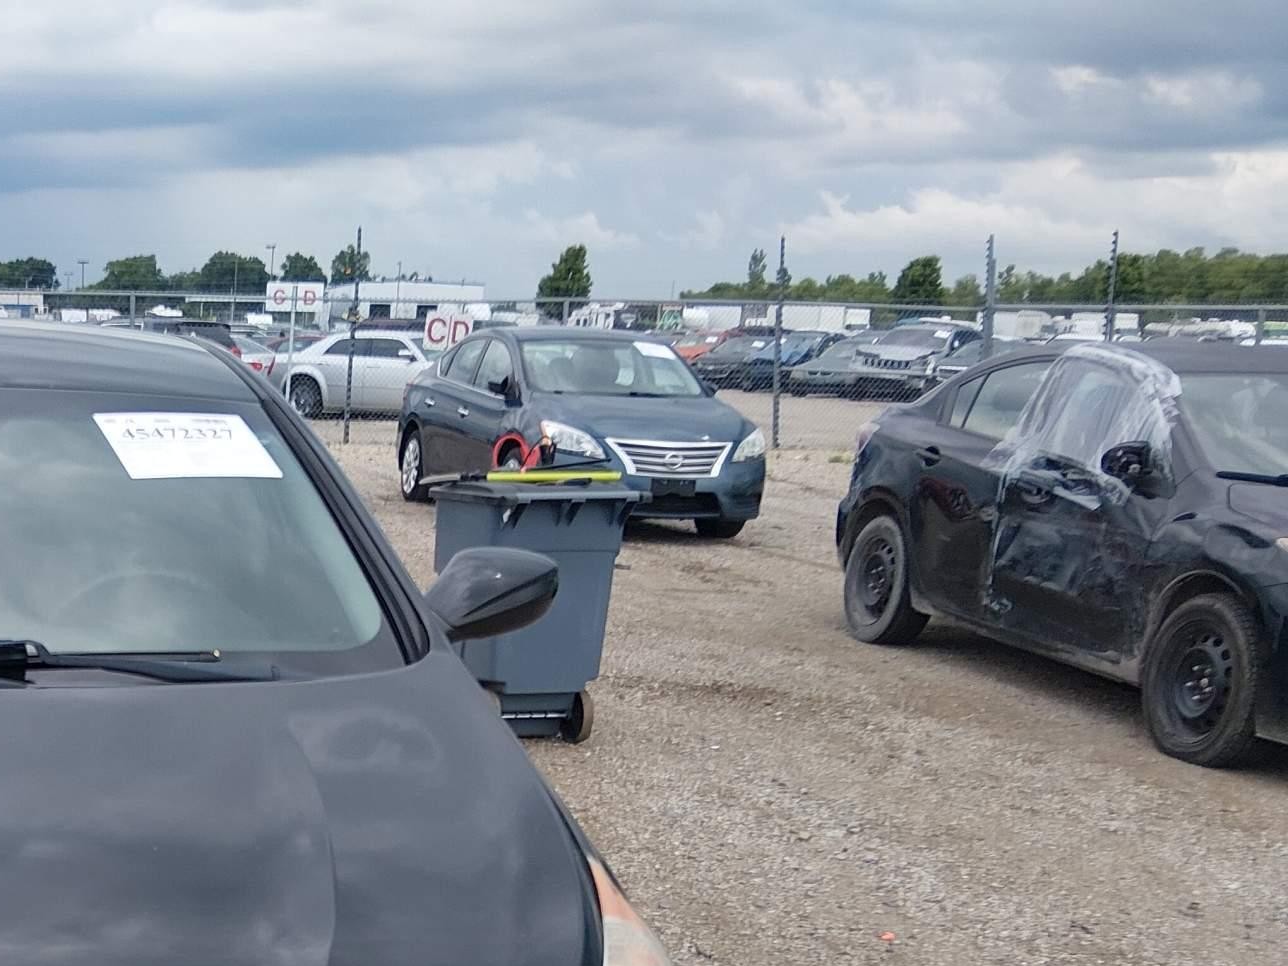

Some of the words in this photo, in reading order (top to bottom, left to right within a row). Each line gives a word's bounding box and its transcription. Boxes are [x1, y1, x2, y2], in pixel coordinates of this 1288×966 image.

[273, 289, 286, 305] C
[303, 290, 316, 305] D
[427, 318, 447, 343] C
[451, 321, 470, 344] D
[122, 427, 233, 441] 45472327
